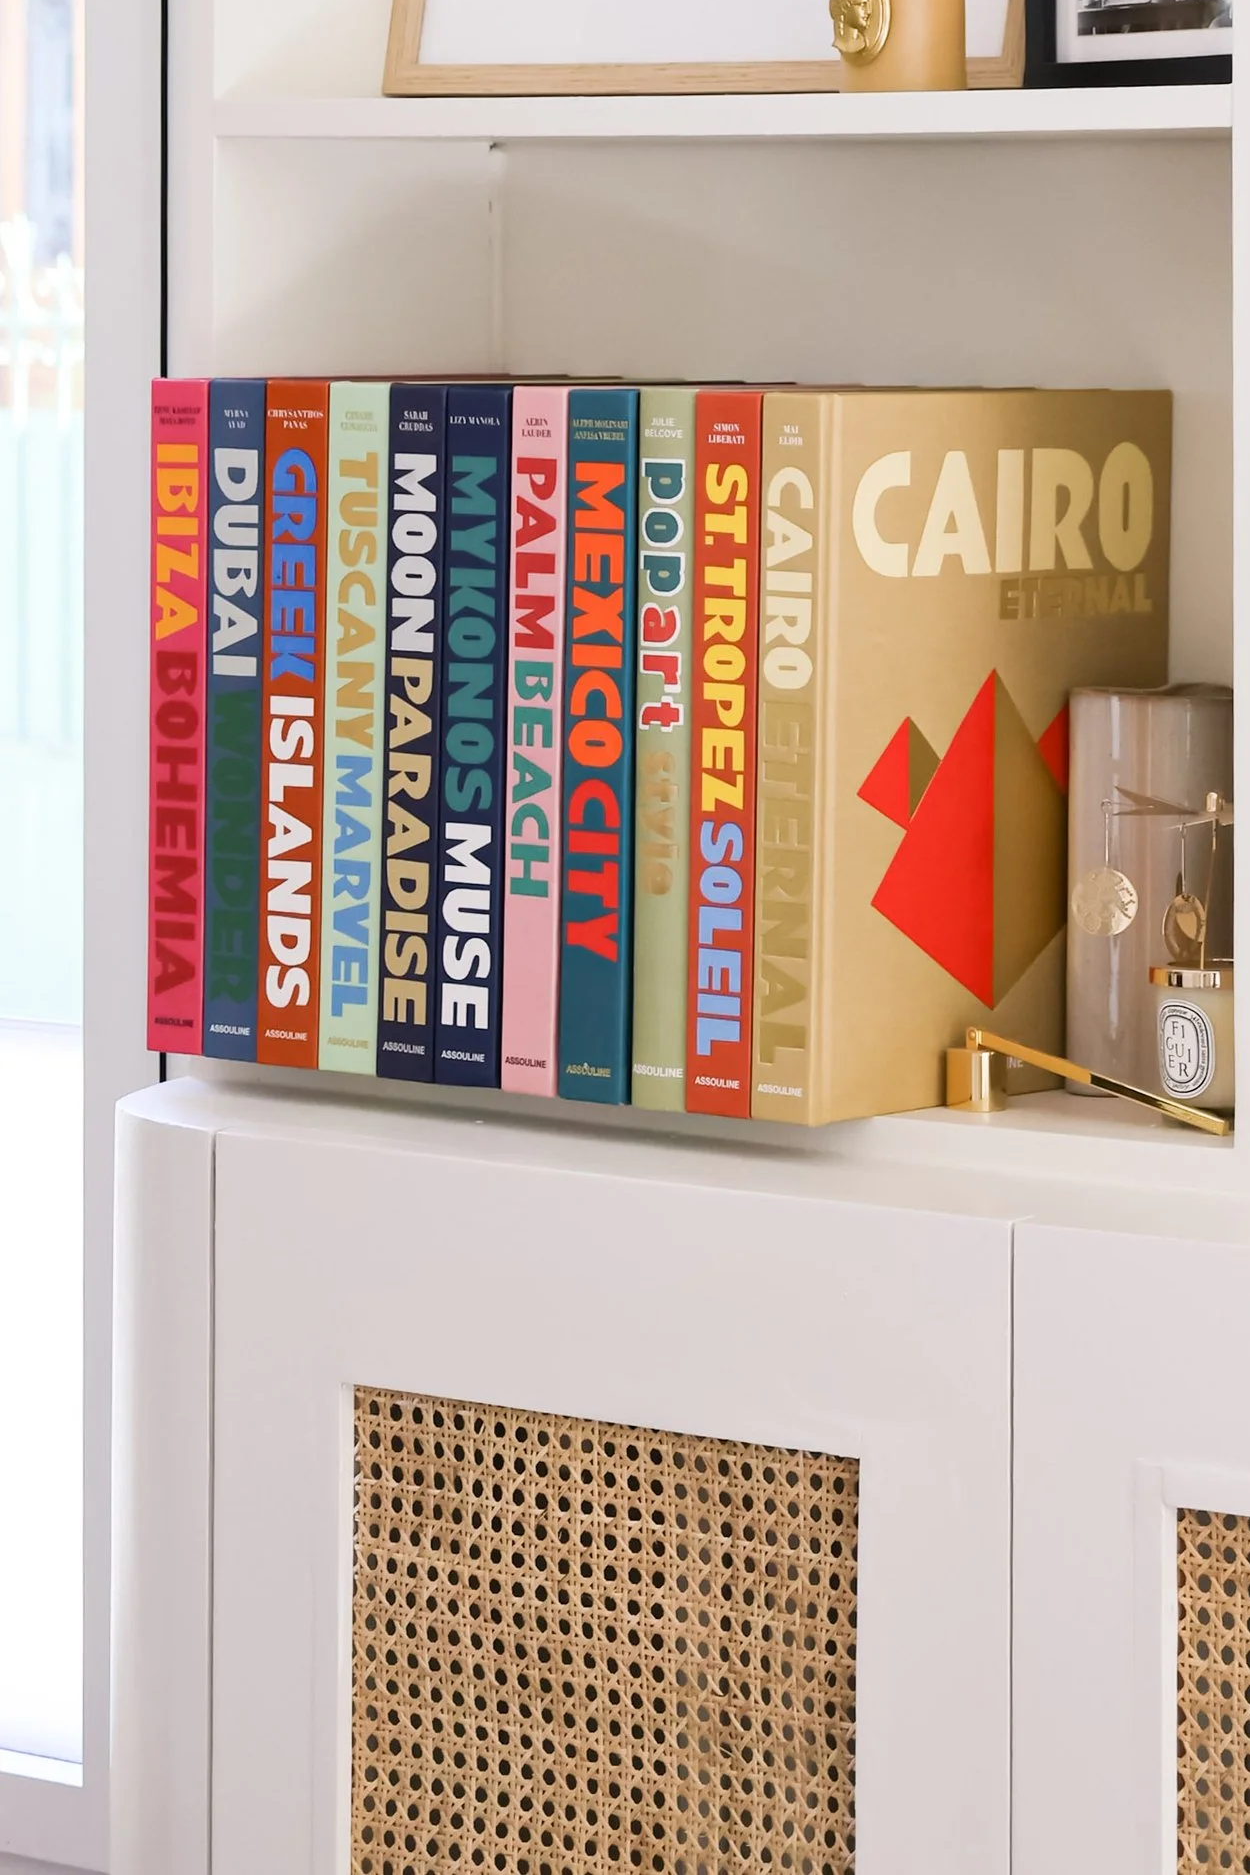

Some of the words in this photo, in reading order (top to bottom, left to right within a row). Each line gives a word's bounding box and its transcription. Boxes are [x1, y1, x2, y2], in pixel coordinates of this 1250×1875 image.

[267, 409, 324, 419] CHRYSANTHOS
[283, 420, 308, 429] PANAS
[403, 410, 428, 420] SARAH
[449, 415, 467, 425] LIZY
[468, 416, 501, 426] MANOLA
[521, 428, 552, 438] LAUDER
[525, 417, 549, 427] AERIN
[644, 428, 684, 439] BELCOVE
[651, 417, 675, 427] JULIE
[708, 434, 746, 445] LIBERATI
[713, 422, 741, 433] SIMON
[155, 444, 199, 641] IBIZA
[390, 453, 438, 654] MOON
[513, 457, 557, 650] PALM
[704, 463, 749, 546] ST.
[852, 441, 1154, 577] CAIRO
[212, 448, 259, 677] DUBAI
[270, 447, 318, 683] GREEK
[335, 452, 379, 750] TUSCANY
[568, 462, 625, 768] MEXICO
[763, 466, 814, 690] CAIRO
[998, 573, 1152, 621] ETERNAL
[444, 455, 498, 813] MYKONOS
[701, 558, 747, 813] TROPEZ
[154, 651, 198, 997] BOHEMIA
[510, 660, 554, 898] BEACH
[209, 687, 258, 1004] WONDER
[265, 695, 315, 1009] ISLANDS
[331, 754, 374, 1018] MARVEL
[383, 657, 434, 1026] PARADISE
[566, 779, 621, 963] CITY
[757, 700, 814, 1067] ETERNAL
[441, 822, 493, 1030] MUSE
[696, 821, 744, 1057] SOLEIL
[209, 1023, 251, 1037] ASSOULINE
[265, 1028, 308, 1042] ASSOULINE
[383, 1040, 426, 1055] ASSOULINE
[441, 1049, 486, 1063] ASSOULINE
[505, 1055, 547, 1069] ASSOULINE
[566, 1063, 612, 1078] ASSOULINE
[633, 1063, 684, 1079] ASSOULINE
[695, 1076, 740, 1090] ASSOULINE
[757, 1083, 803, 1097] ASSOULINE
